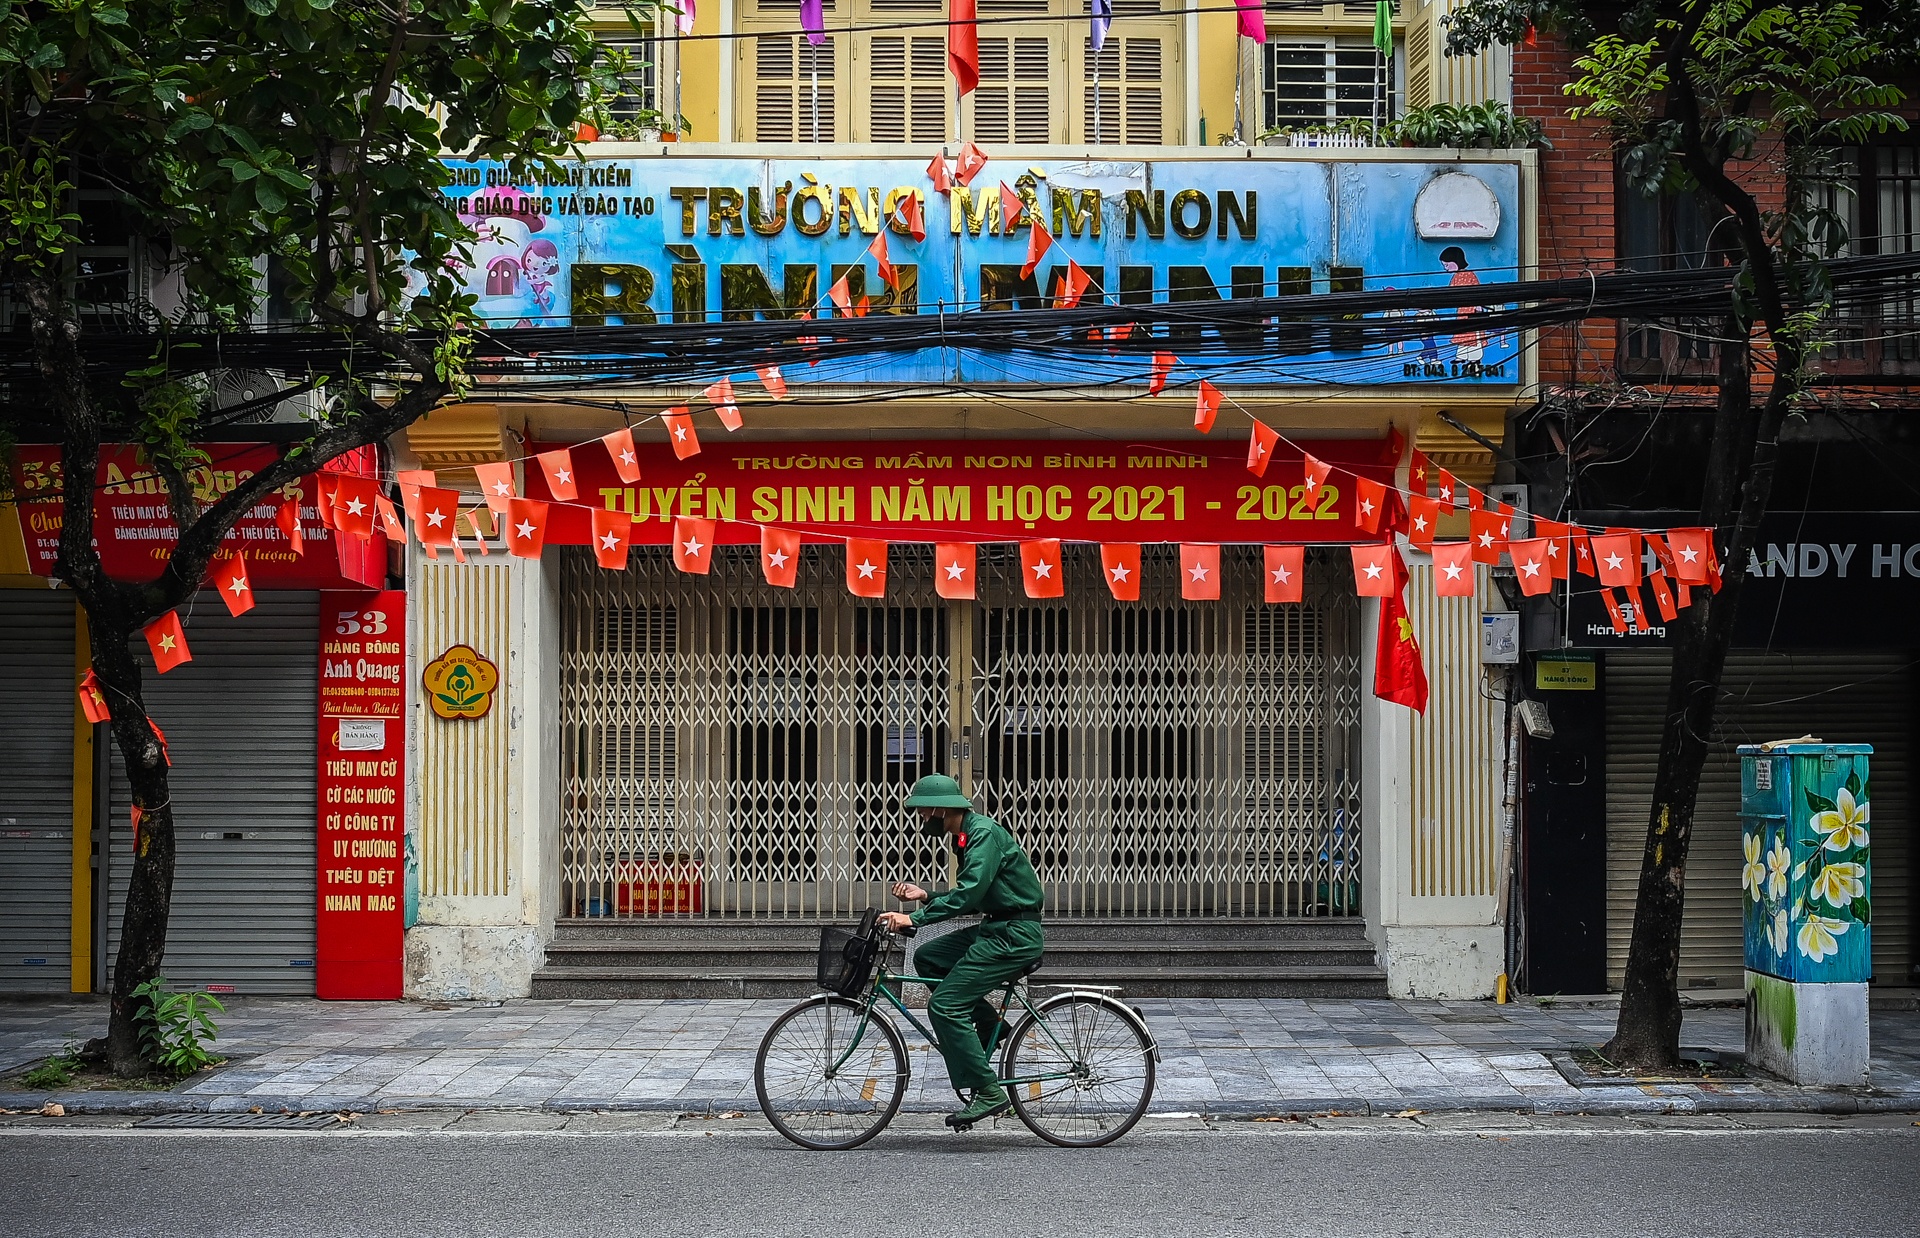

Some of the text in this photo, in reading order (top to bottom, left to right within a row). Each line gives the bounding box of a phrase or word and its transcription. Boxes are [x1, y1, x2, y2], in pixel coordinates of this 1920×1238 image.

[446, 168, 481, 187] BND
[589, 163, 631, 187] KIẾM
[474, 193, 514, 216] GIÁO
[519, 197, 553, 219] DỤC
[557, 193, 580, 216] VÀ
[584, 193, 618, 216] ĐÀO
[623, 196, 655, 220] TẠO
[670, 166, 1258, 240] TRƯỜNG MẦM NON
[732, 450, 1208, 470] TRƯỜNG MẦM NON BÌNH MINH
[598, 472, 1340, 529] TUYỂN SINH NĂM HỌC 2021 - 2022
[111, 504, 136, 520] THÊU
[136, 506, 154, 520] MAY
[114, 526, 137, 540] BĂNG
[137, 522, 160, 540] KHẨU
[241, 524, 263, 540] THÊU
[264, 525, 280, 542] DỆT
[308, 525, 328, 540] MÁC
[255, 548, 298, 562] lượng
[336, 610, 388, 635] 53
[324, 639, 400, 654] HÀNG BÔNG
[323, 658, 400, 684] Anh Quang
[322, 701, 341, 713] Bán
[342, 701, 362, 713] buôn
[371, 702, 390, 714] Bán
[326, 757, 398, 777] THÊU MAY CỜ
[326, 784, 396, 804] CỜ CÁC NƯỚC
[326, 811, 396, 831] CỜ CÔNG TY
[333, 838, 397, 858] UY CHƯƠNG
[325, 867, 395, 887] THÊU DỆT
